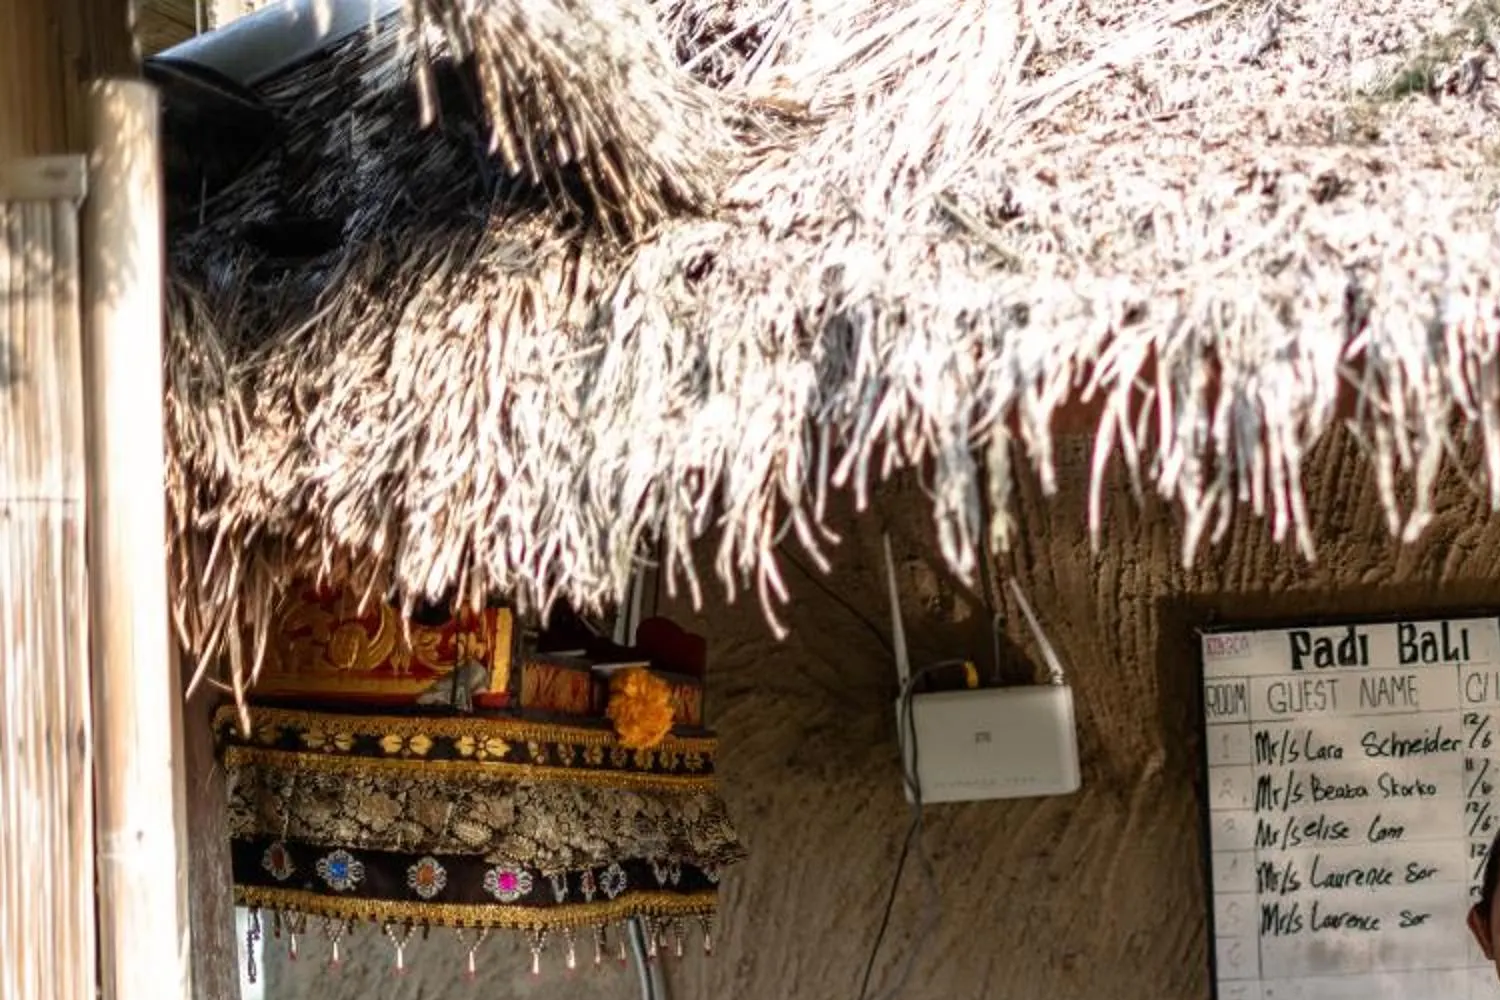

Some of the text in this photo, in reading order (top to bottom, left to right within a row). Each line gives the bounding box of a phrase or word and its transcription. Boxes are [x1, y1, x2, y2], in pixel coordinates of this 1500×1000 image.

[1204, 683, 1248, 717] ROOM
[1267, 678, 1340, 714] GUEST
[1359, 675, 1419, 708] NAME
